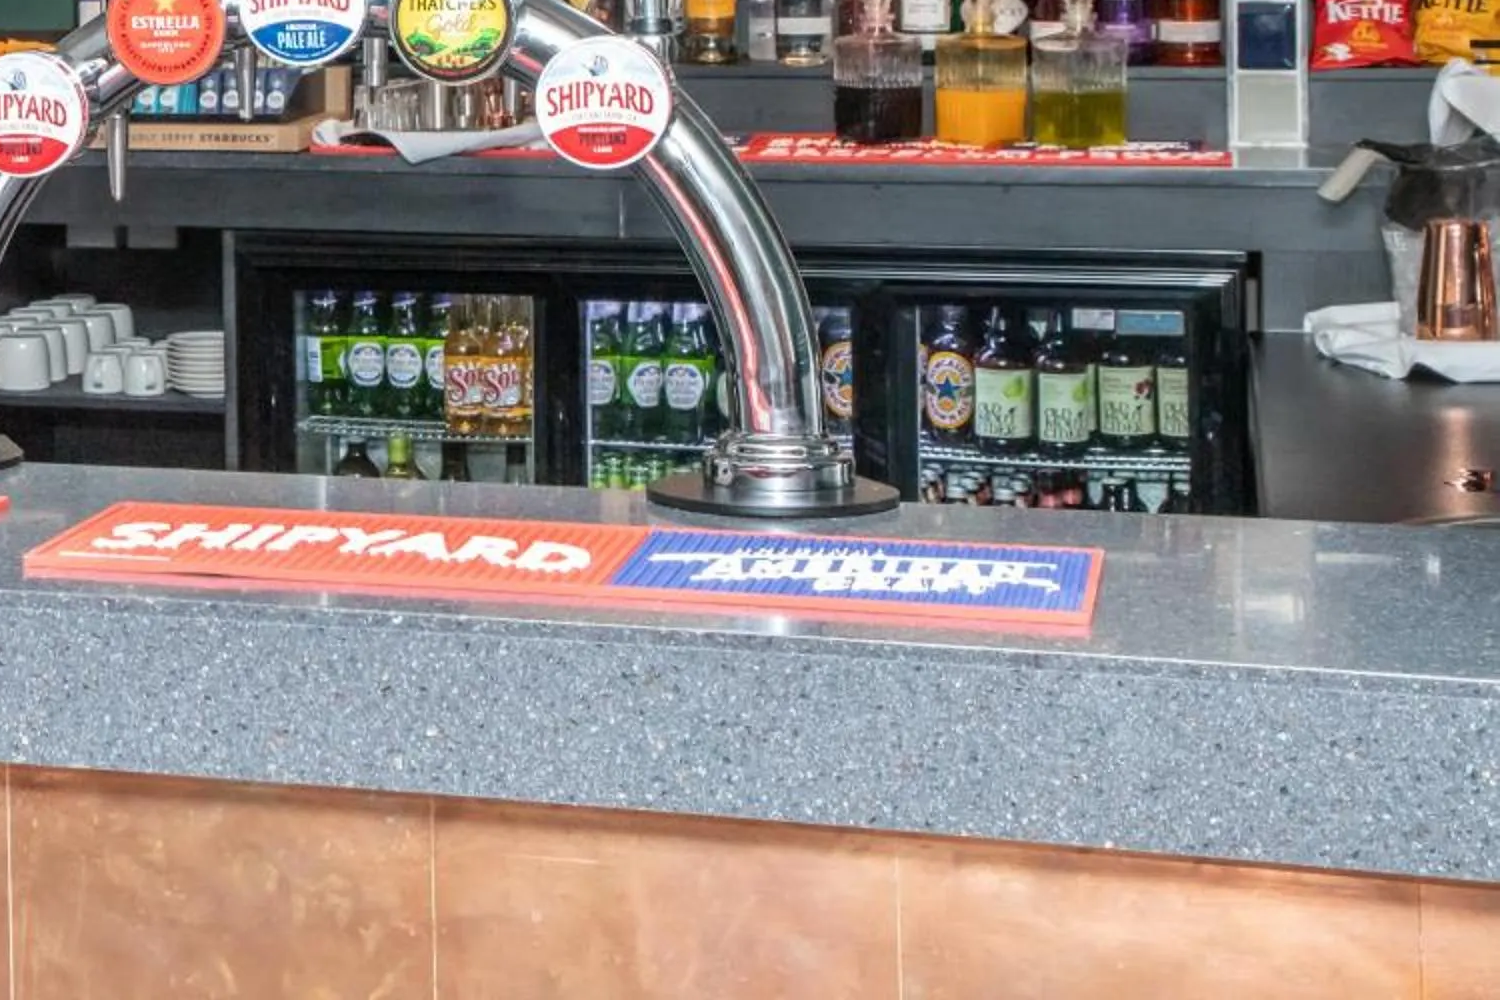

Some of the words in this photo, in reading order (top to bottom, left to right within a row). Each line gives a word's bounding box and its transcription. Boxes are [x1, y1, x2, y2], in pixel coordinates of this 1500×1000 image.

[131, 14, 200, 30] ESTRELLA
[277, 31, 304, 49] PALE
[306, 30, 326, 49] ALE
[547, 81, 654, 117] SHIPYARD
[91, 520, 592, 573] SHIPYARD
